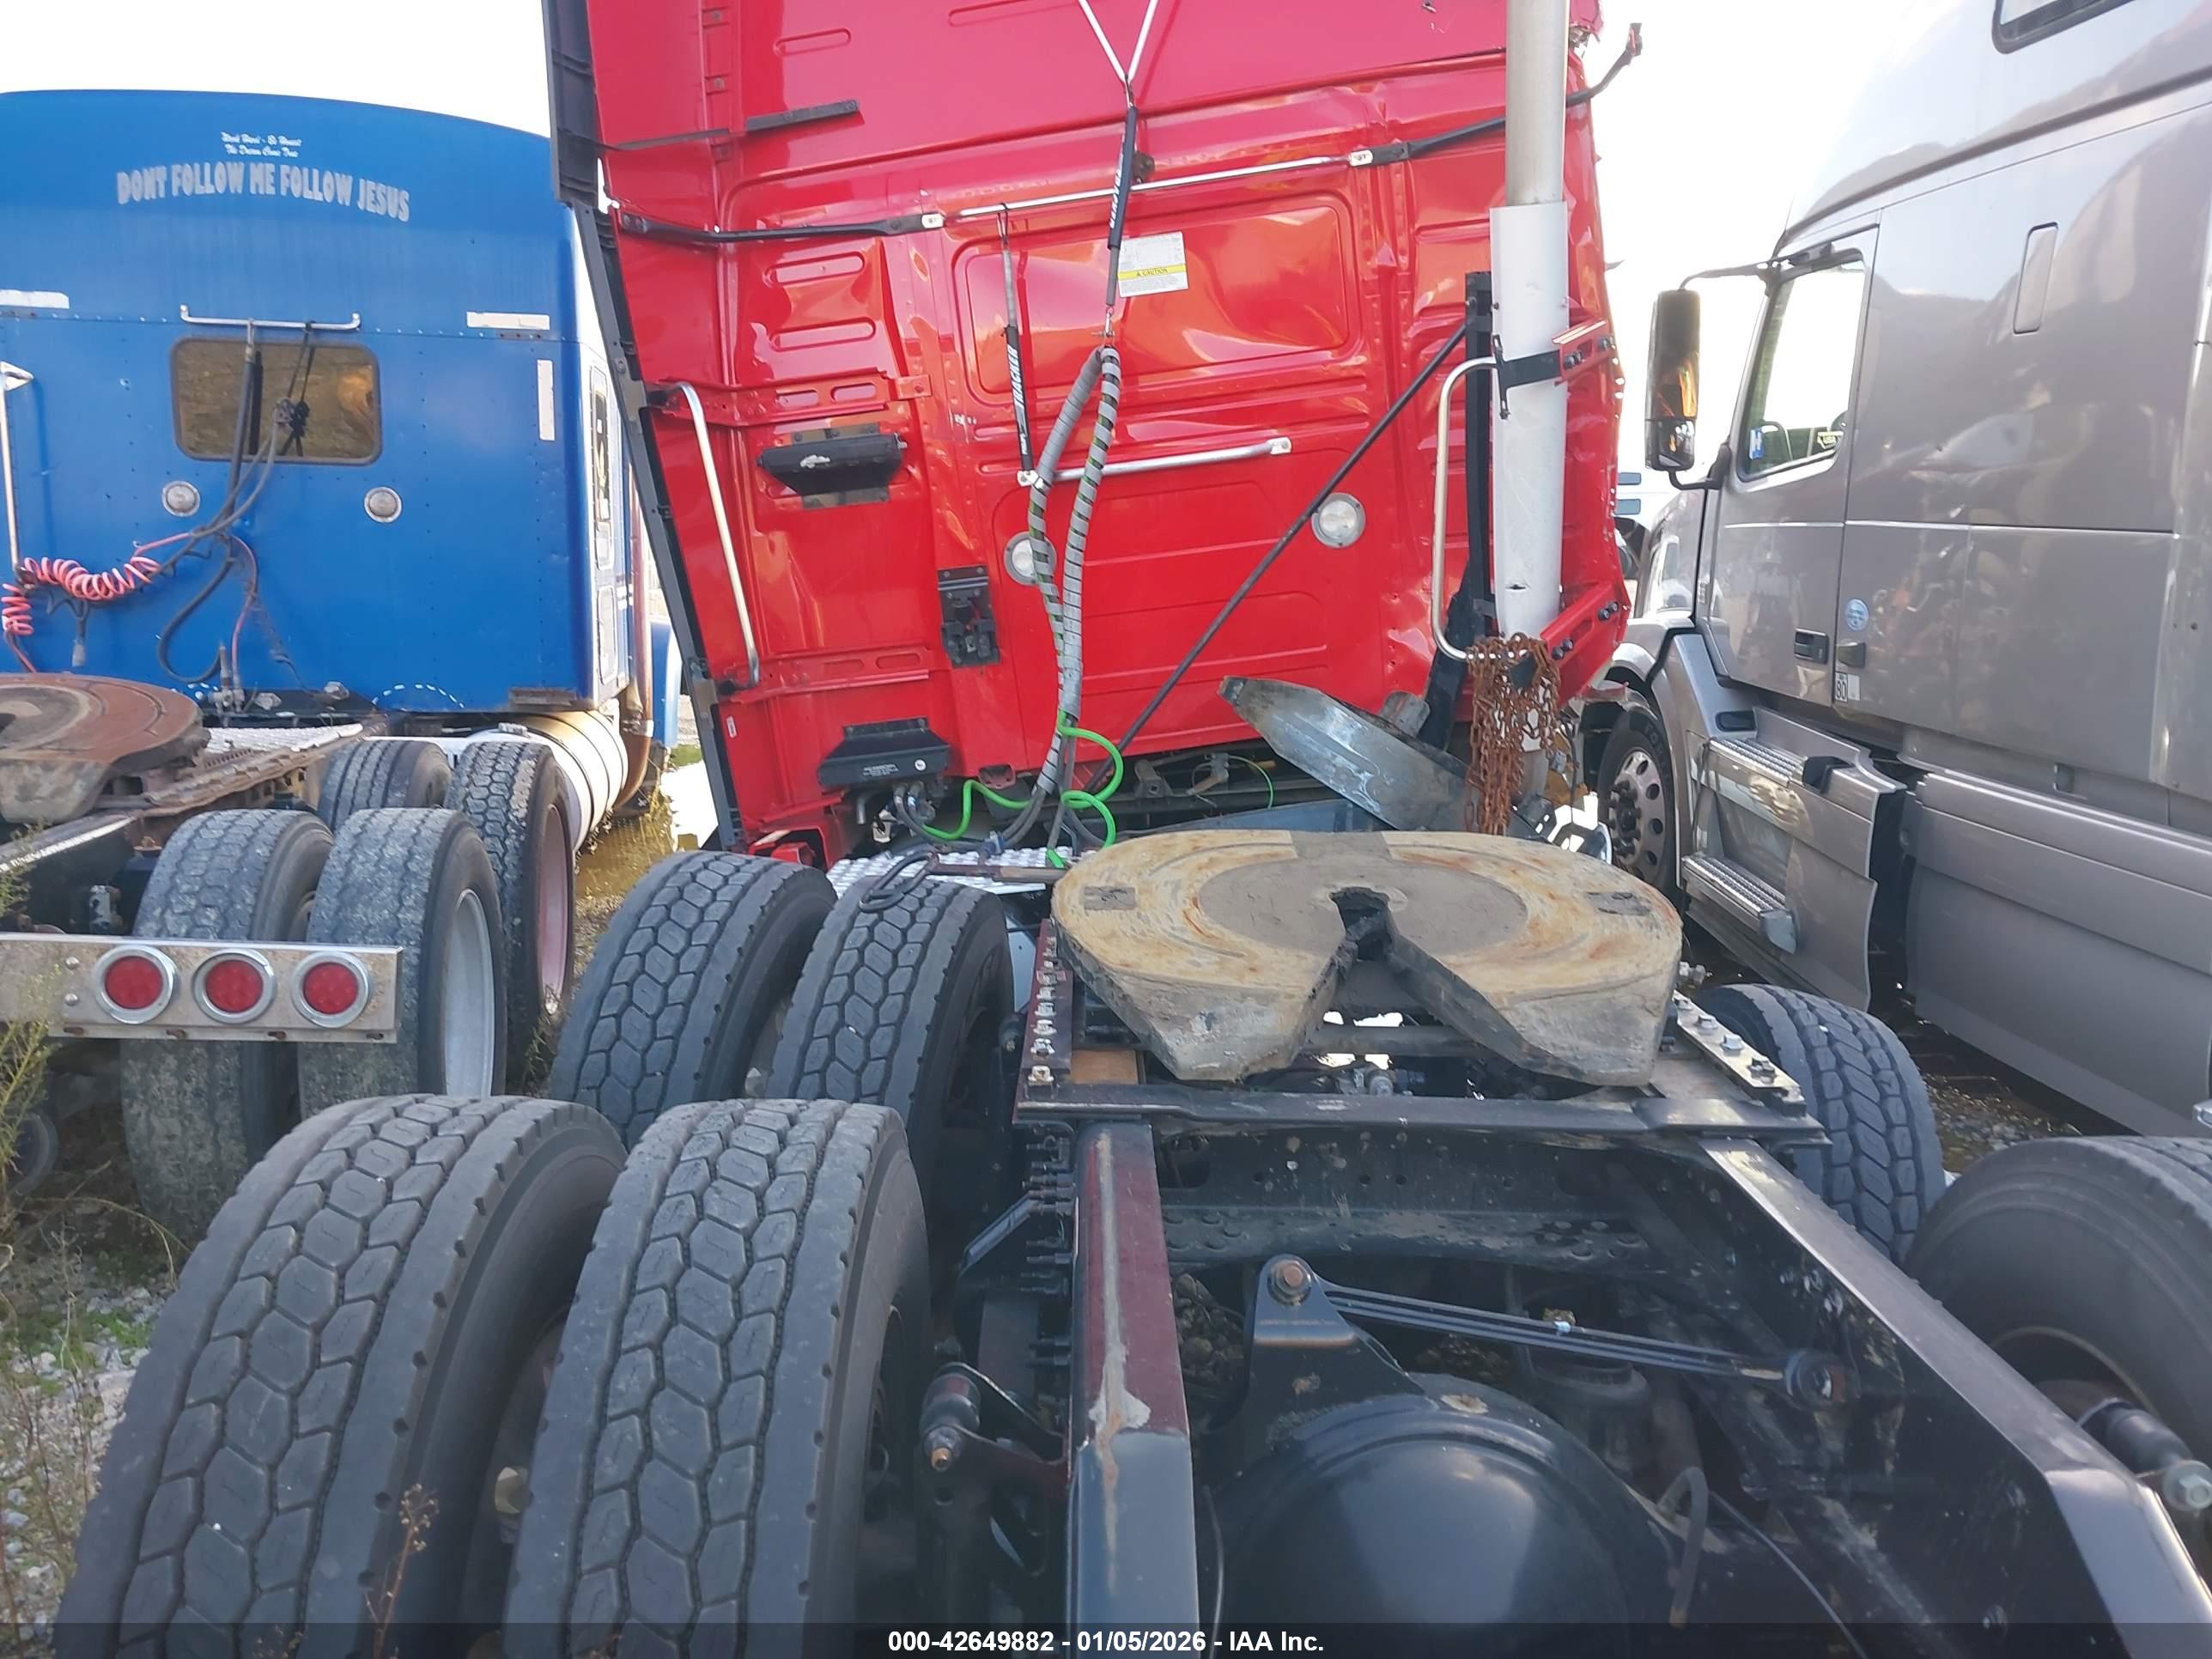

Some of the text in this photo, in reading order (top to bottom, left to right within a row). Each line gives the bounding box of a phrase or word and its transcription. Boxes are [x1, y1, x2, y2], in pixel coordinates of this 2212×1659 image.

[117, 161, 410, 222] DONT FOLLOW ME FOLLOW JESUS
[1006, 343, 1025, 409] TRACKER
[1836, 679, 1847, 701] 80
